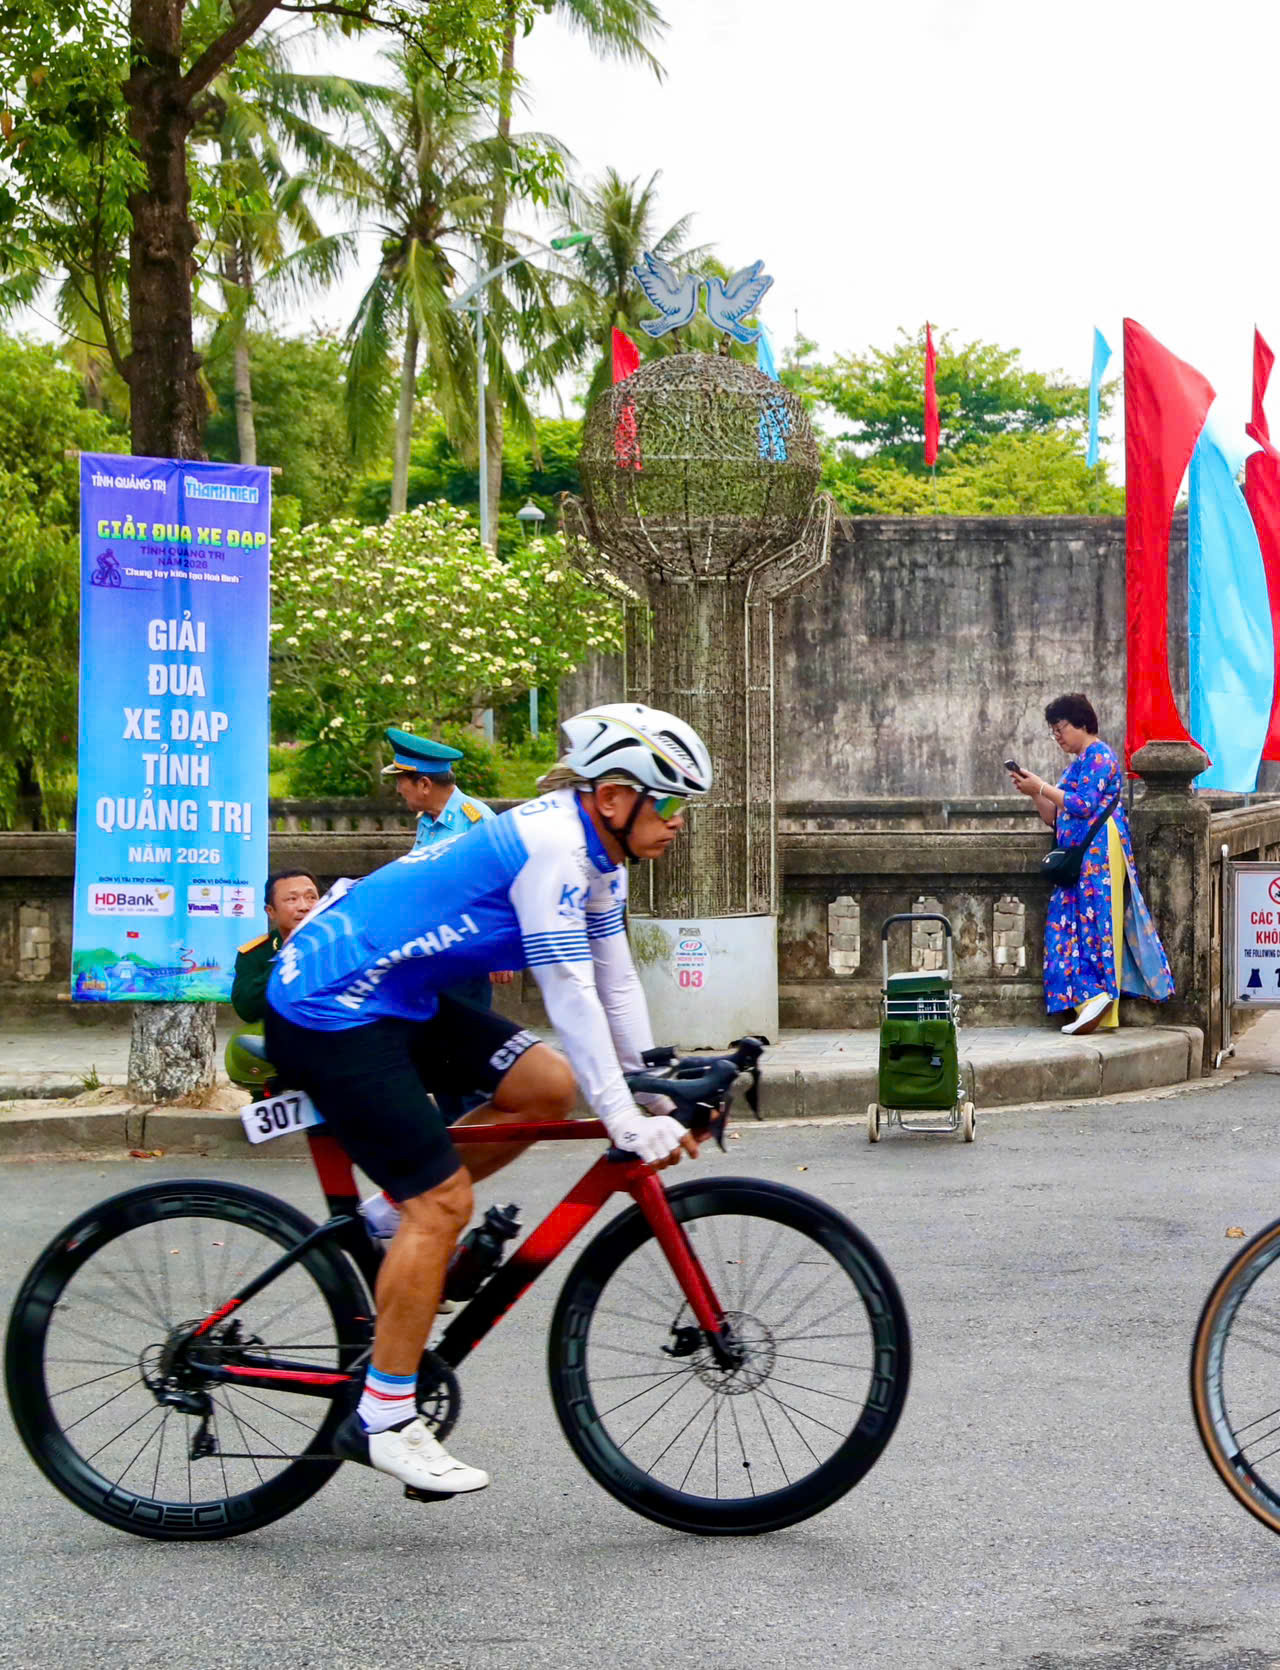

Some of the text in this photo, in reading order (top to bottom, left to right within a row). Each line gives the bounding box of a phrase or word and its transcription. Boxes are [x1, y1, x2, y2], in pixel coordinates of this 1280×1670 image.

[91, 471, 167, 495] TỈNH QUẢNG TRỊ
[97, 514, 267, 555] GIẢI ĐUA XE ĐẠP
[147, 610, 206, 653] GIẢI
[147, 663, 207, 697] ĐUA
[122, 708, 229, 749] XE ĐẠP
[141, 743, 210, 787] TỈNH
[95, 788, 253, 841] QUẢNG TRỊ
[128, 844, 221, 865] NĂM 2026
[95, 893, 154, 907] HDBank
[187, 903, 219, 912] Vinamilk
[1250, 909, 1274, 925] CÁC
[1244, 949, 1252, 959] THE
[679, 969, 705, 988] 03
[255, 1096, 302, 1134] 307
